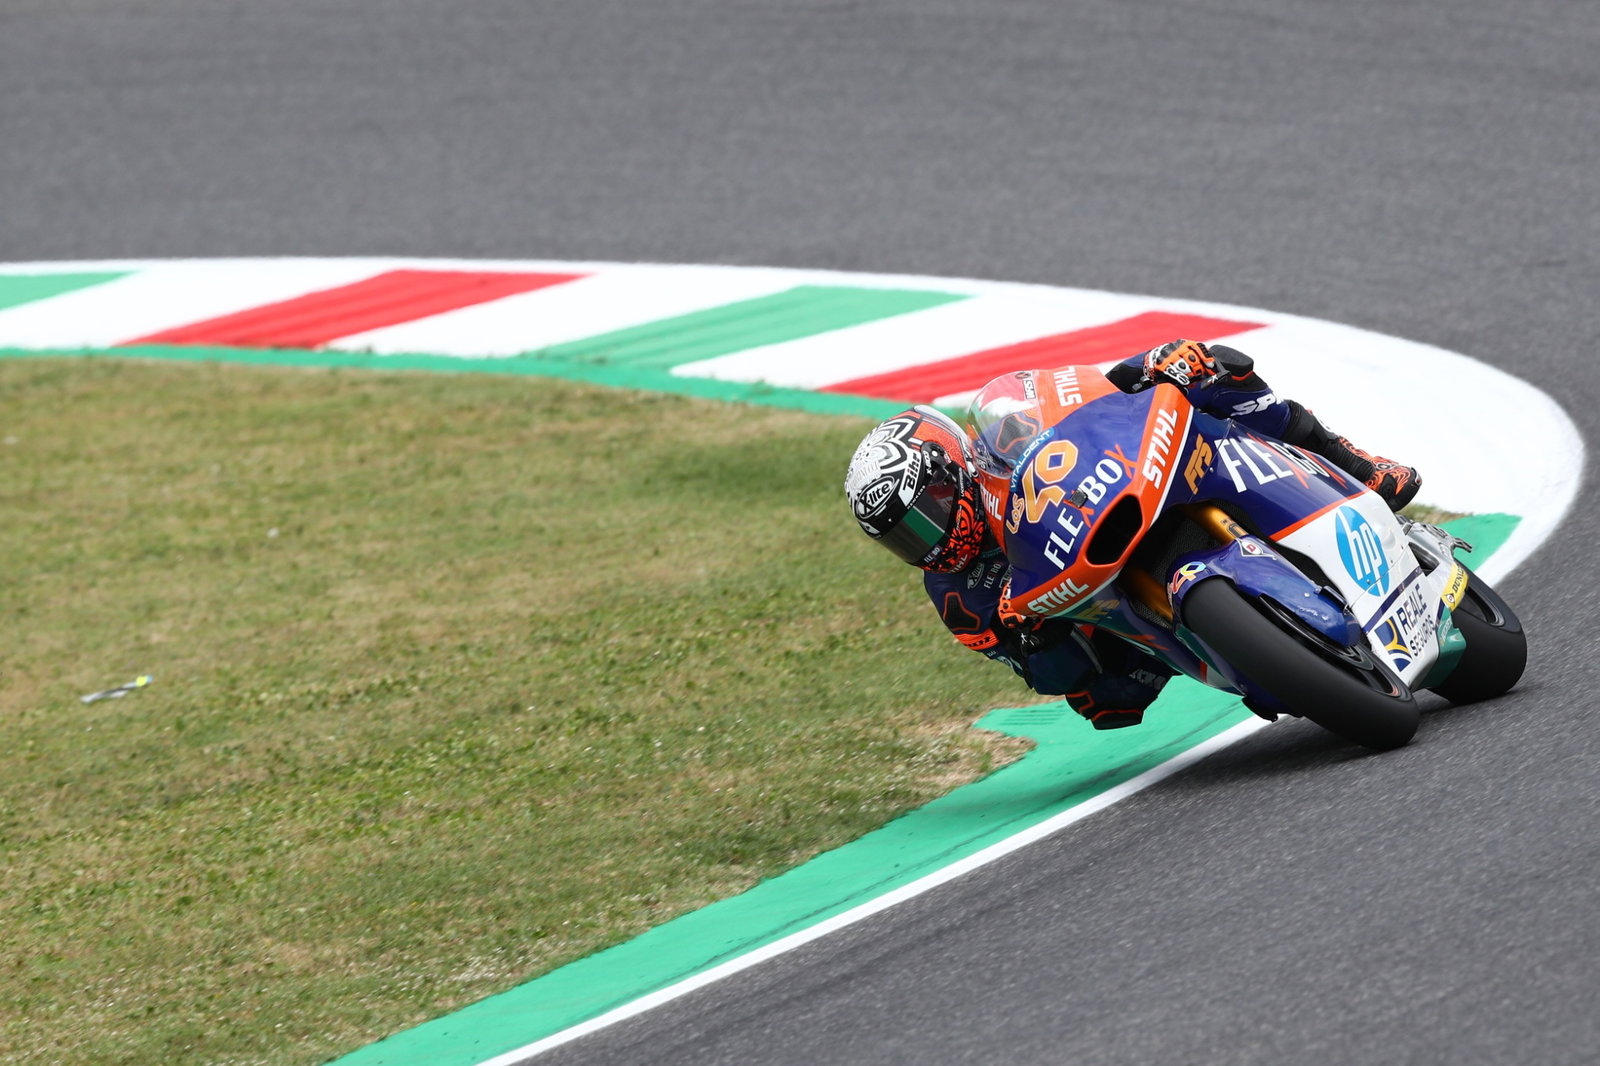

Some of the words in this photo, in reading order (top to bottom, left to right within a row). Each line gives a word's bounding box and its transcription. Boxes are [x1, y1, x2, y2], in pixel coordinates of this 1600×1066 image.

[1053, 366, 1083, 407] STIHL
[903, 452, 920, 491] Bihr
[1010, 430, 1051, 488] VITALDENT
[1142, 409, 1178, 490] STIHL
[1022, 440, 1079, 524] 40
[950, 554, 968, 574] TIHL
[1335, 506, 1388, 597] hp
[1027, 578, 1090, 614] STIHL
[1396, 584, 1427, 636] REALE
